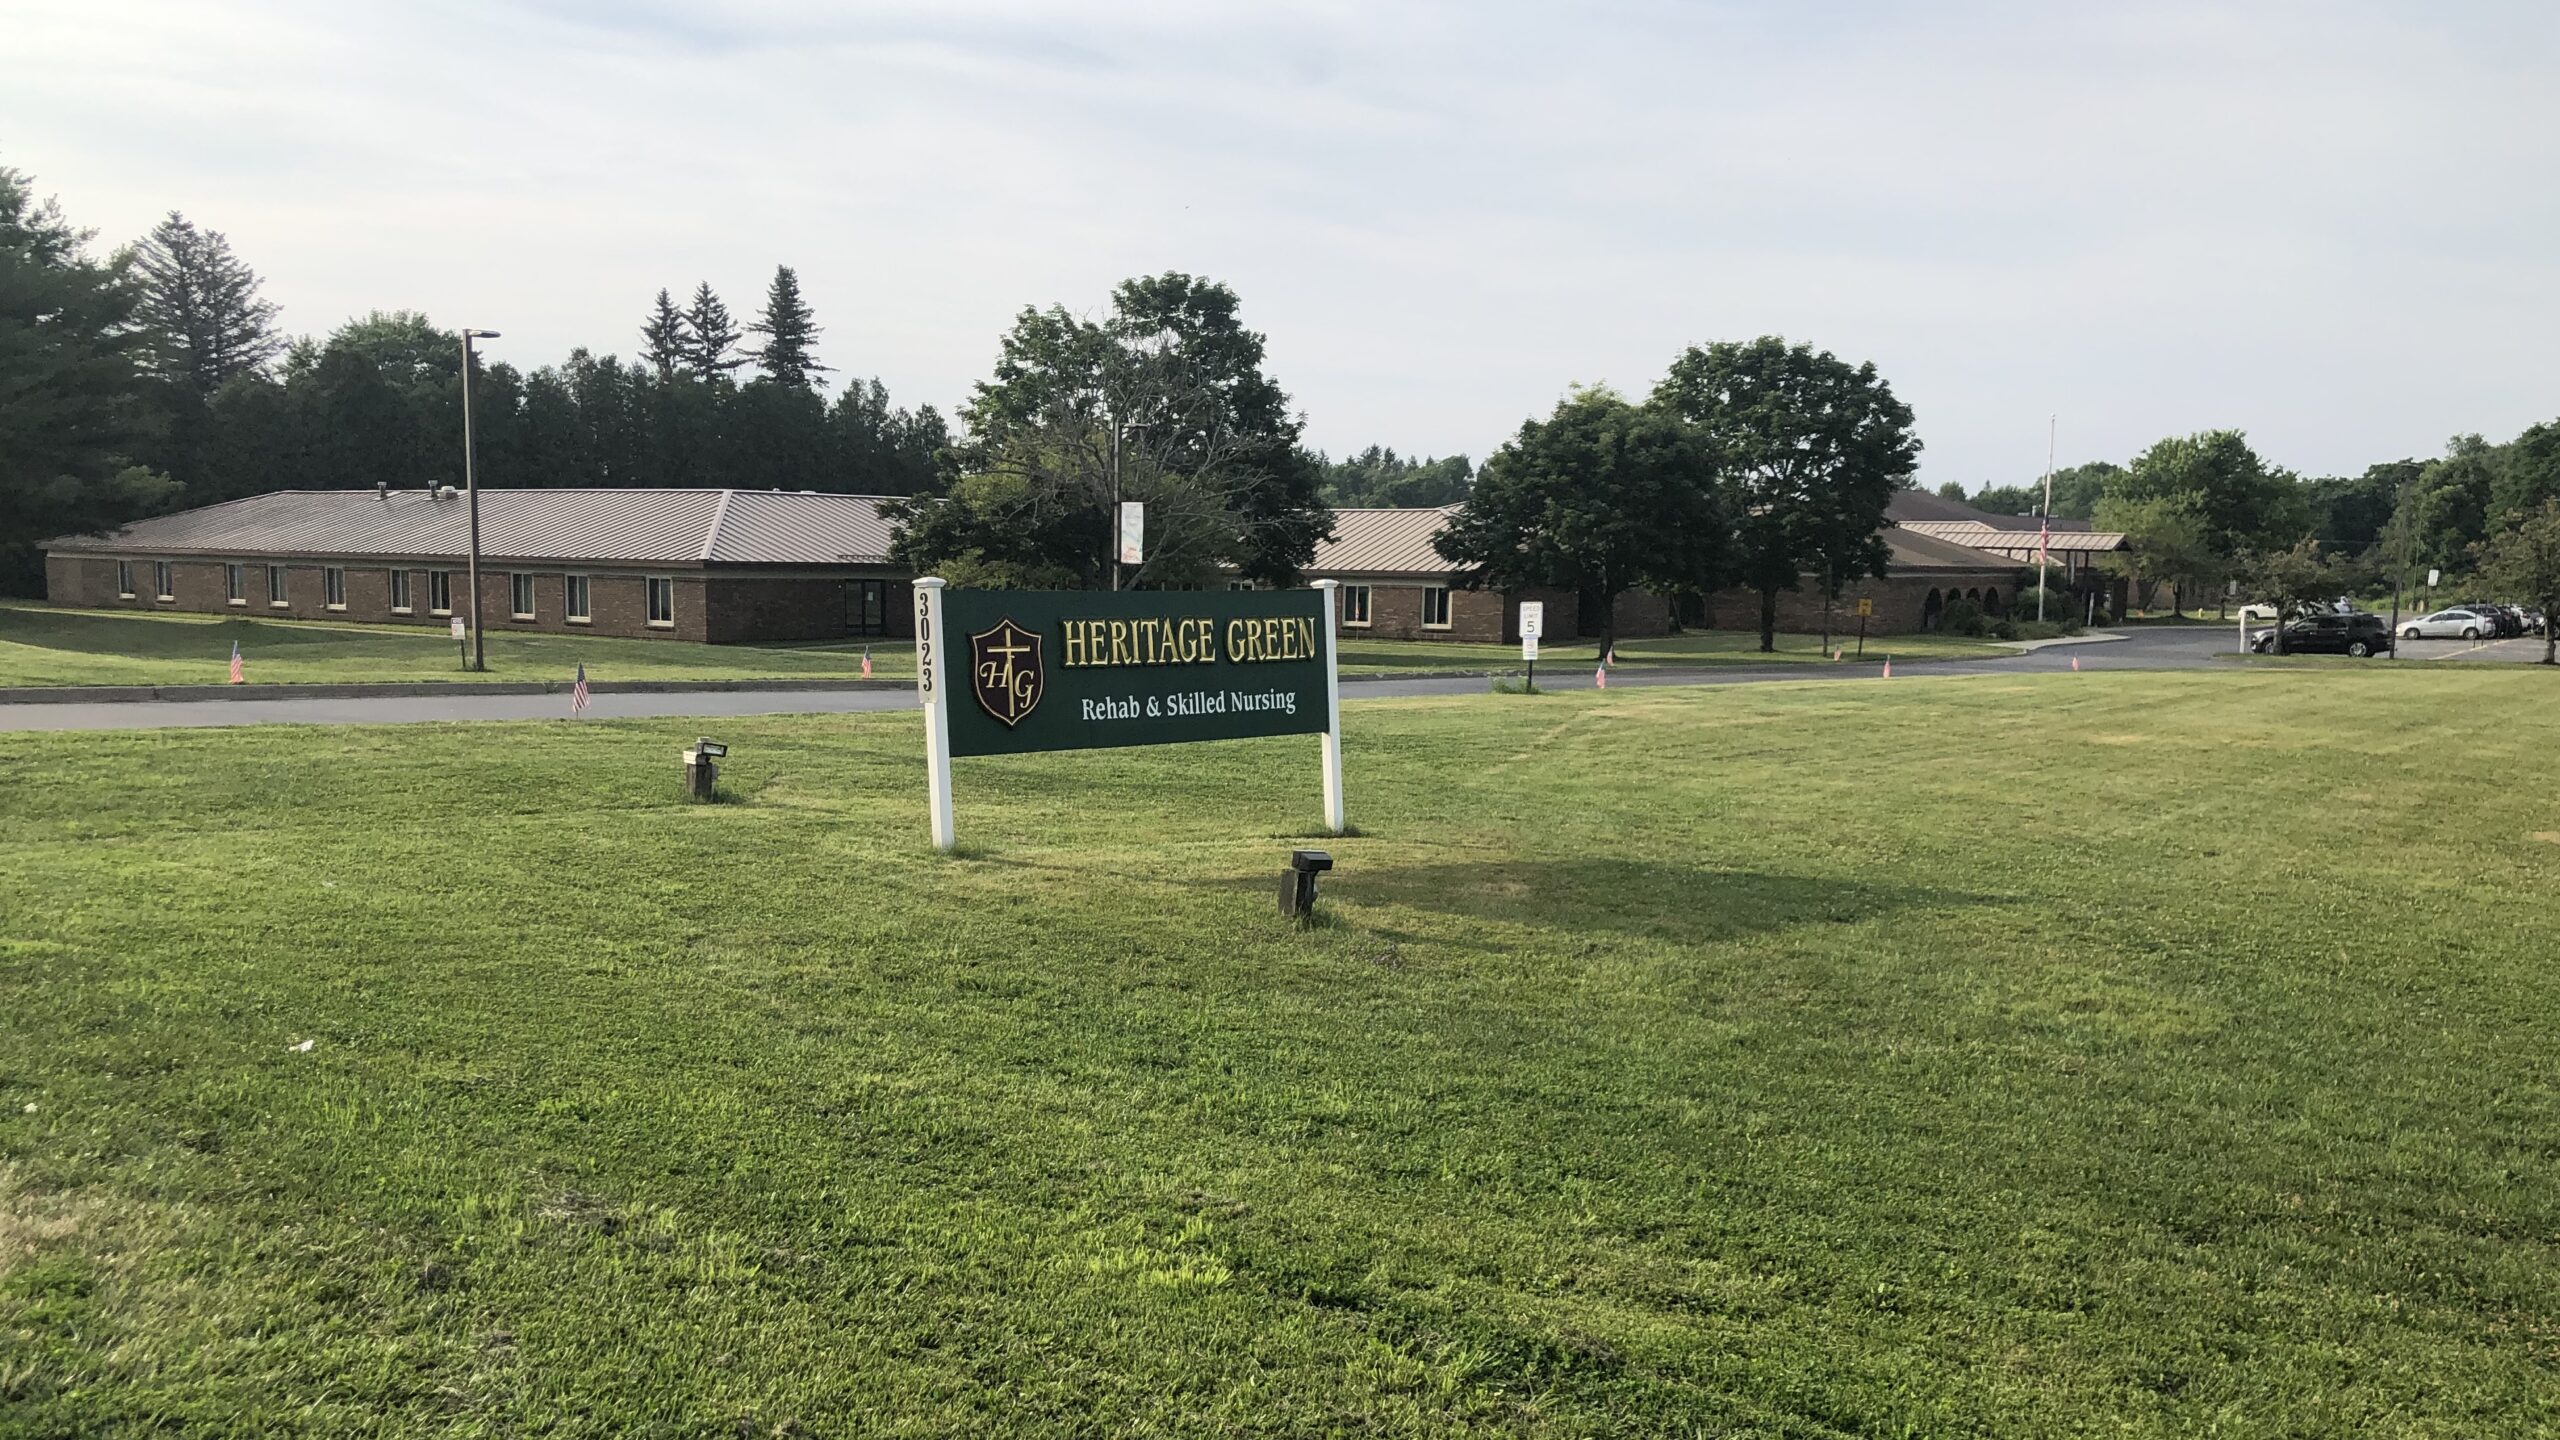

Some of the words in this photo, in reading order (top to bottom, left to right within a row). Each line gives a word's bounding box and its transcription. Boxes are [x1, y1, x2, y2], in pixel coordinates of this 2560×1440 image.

[920, 592, 932, 692] 3023
[1063, 617, 1216, 666] HERITAGE
[1226, 617, 1316, 663] GREEN
[1527, 620, 1535, 633] 5
[1082, 695, 1141, 721] Rehab
[1146, 696, 1162, 718] &
[1167, 690, 1226, 717] Skilled
[1230, 688, 1296, 715] Nursing
